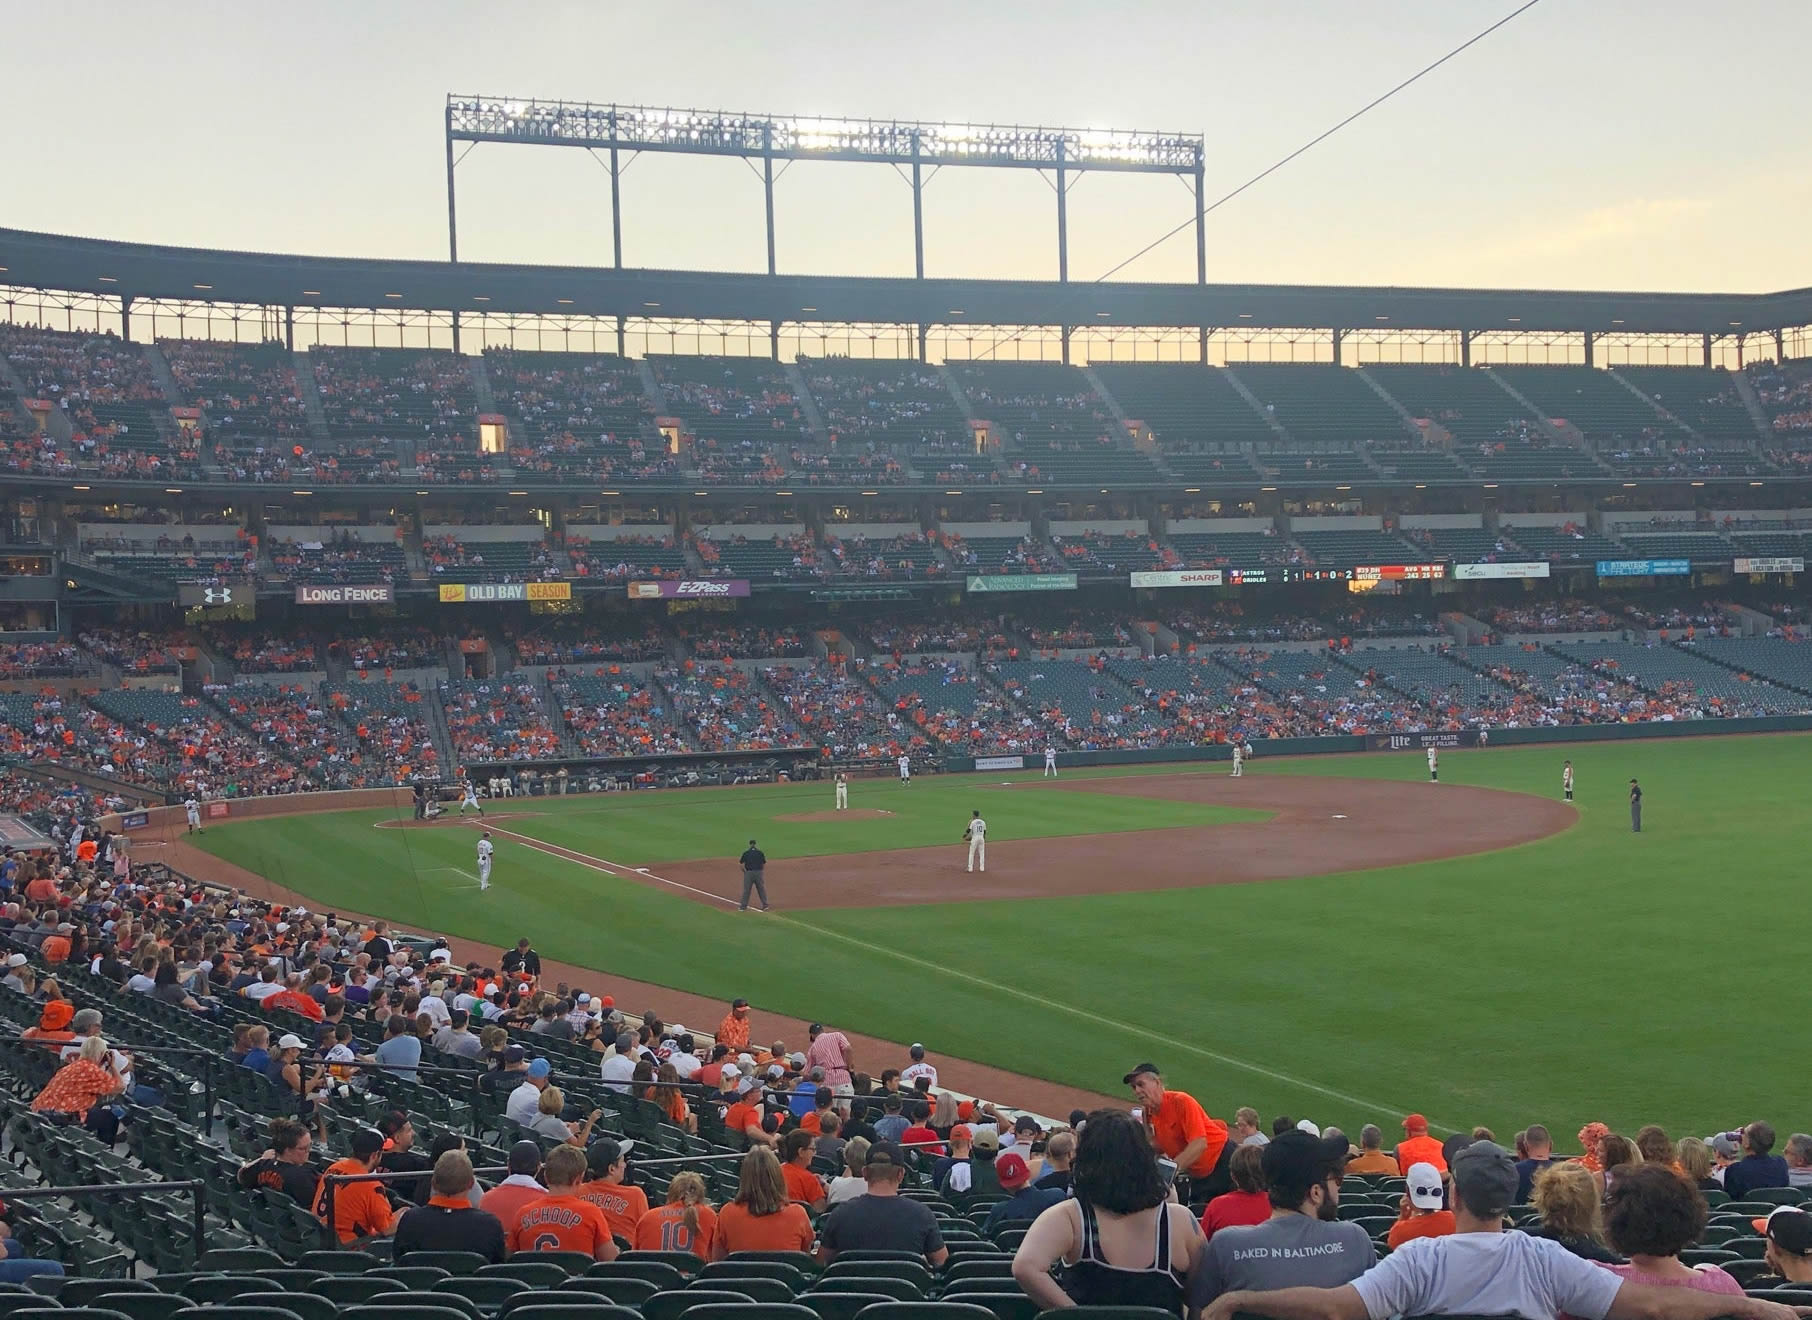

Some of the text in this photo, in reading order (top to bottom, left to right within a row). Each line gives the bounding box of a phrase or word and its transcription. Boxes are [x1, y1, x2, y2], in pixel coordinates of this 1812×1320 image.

[1180, 574, 1220, 582] SHARP
[1314, 570, 1320, 580] 1
[1330, 570, 1338, 580] 0
[1346, 570, 1352, 579] 2
[302, 587, 388, 601] LONG FENCE
[469, 586, 495, 599] OLD
[498, 585, 522, 599] BAY
[530, 583, 567, 598] SEASON
[1390, 735, 1411, 750] Lite
[521, 1206, 582, 1232] SCHOOP
[661, 1220, 695, 1252] 10
[1233, 1242, 1344, 1260] BAKED IN BALTIMORE
